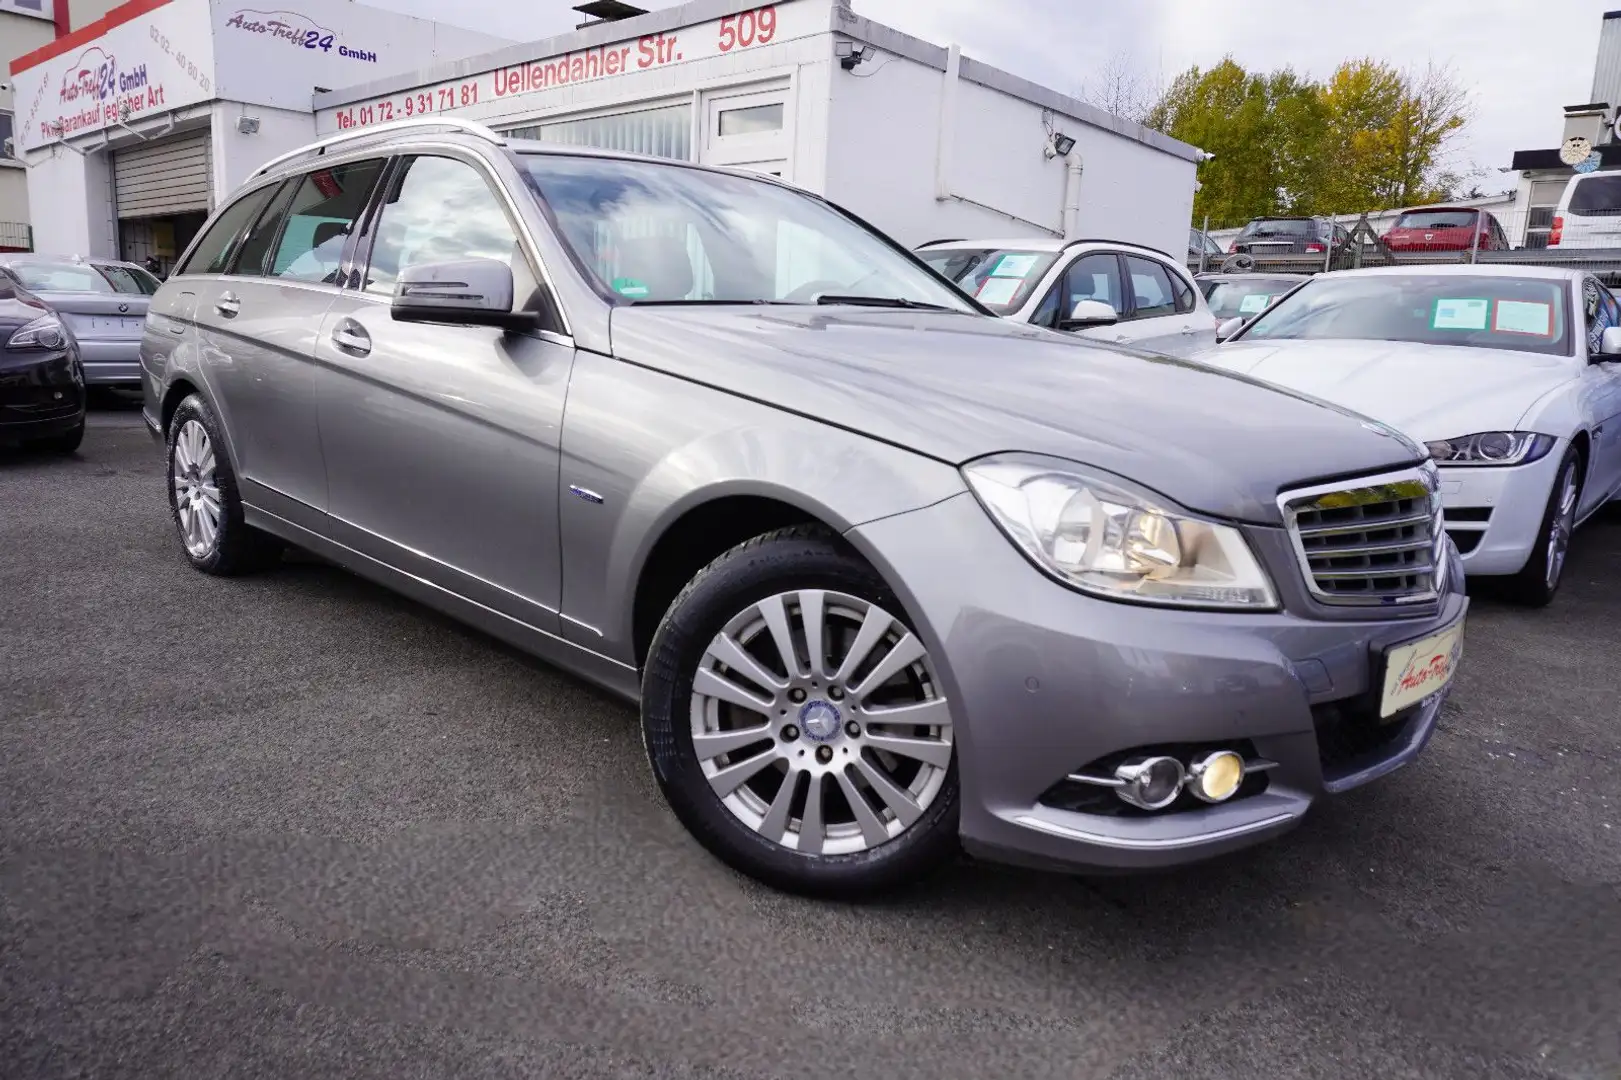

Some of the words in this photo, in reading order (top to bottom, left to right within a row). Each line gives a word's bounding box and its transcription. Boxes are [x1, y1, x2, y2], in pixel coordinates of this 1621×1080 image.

[338, 45, 377, 63] GmbH
[494, 46, 630, 97] Uellendahler
[637, 32, 682, 69] Str.
[718, 5, 777, 52] 509
[119, 63, 147, 93] GmbH
[147, 83, 165, 107] Art
[336, 108, 357, 129] Tel.
[461, 82, 478, 106] 81
